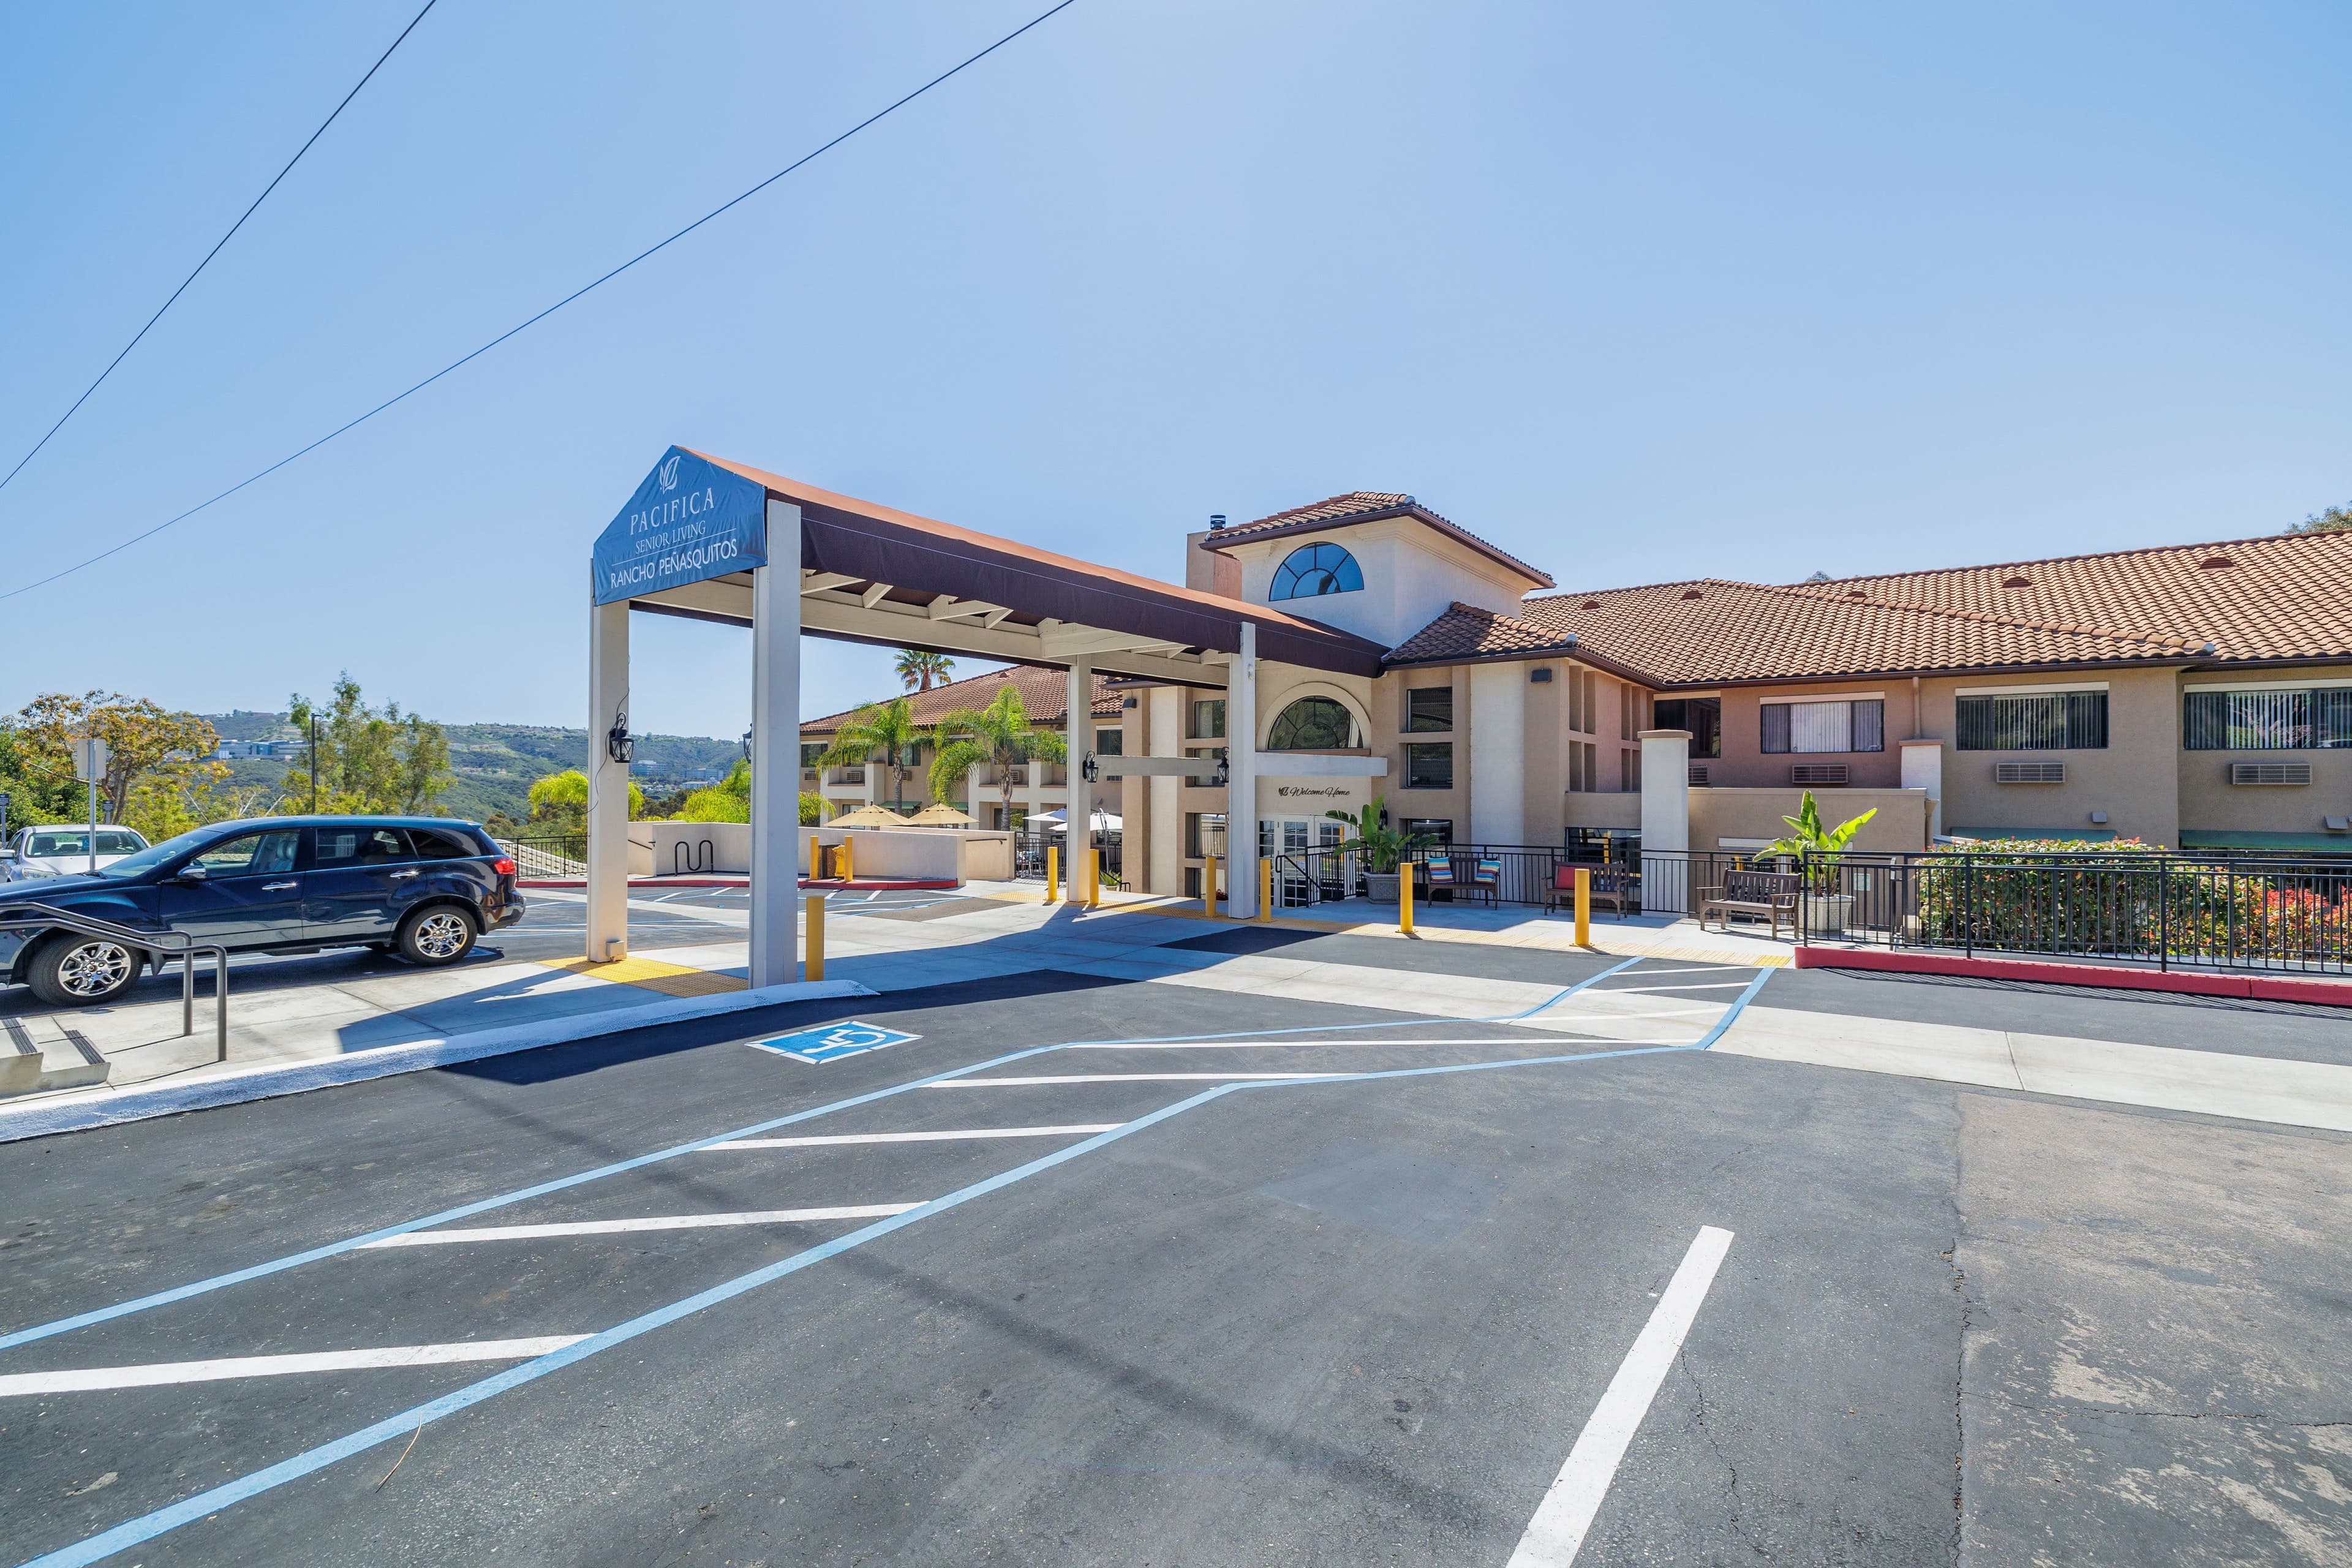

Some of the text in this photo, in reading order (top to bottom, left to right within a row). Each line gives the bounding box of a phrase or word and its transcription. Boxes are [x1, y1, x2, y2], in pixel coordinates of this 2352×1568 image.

[630, 488, 715, 535] PACIFICA
[635, 520, 706, 554] SENIOR LIVING
[610, 539, 737, 589] RANCHO PEÑASQUITOS
[1289, 787, 1351, 797] Welcome Home
